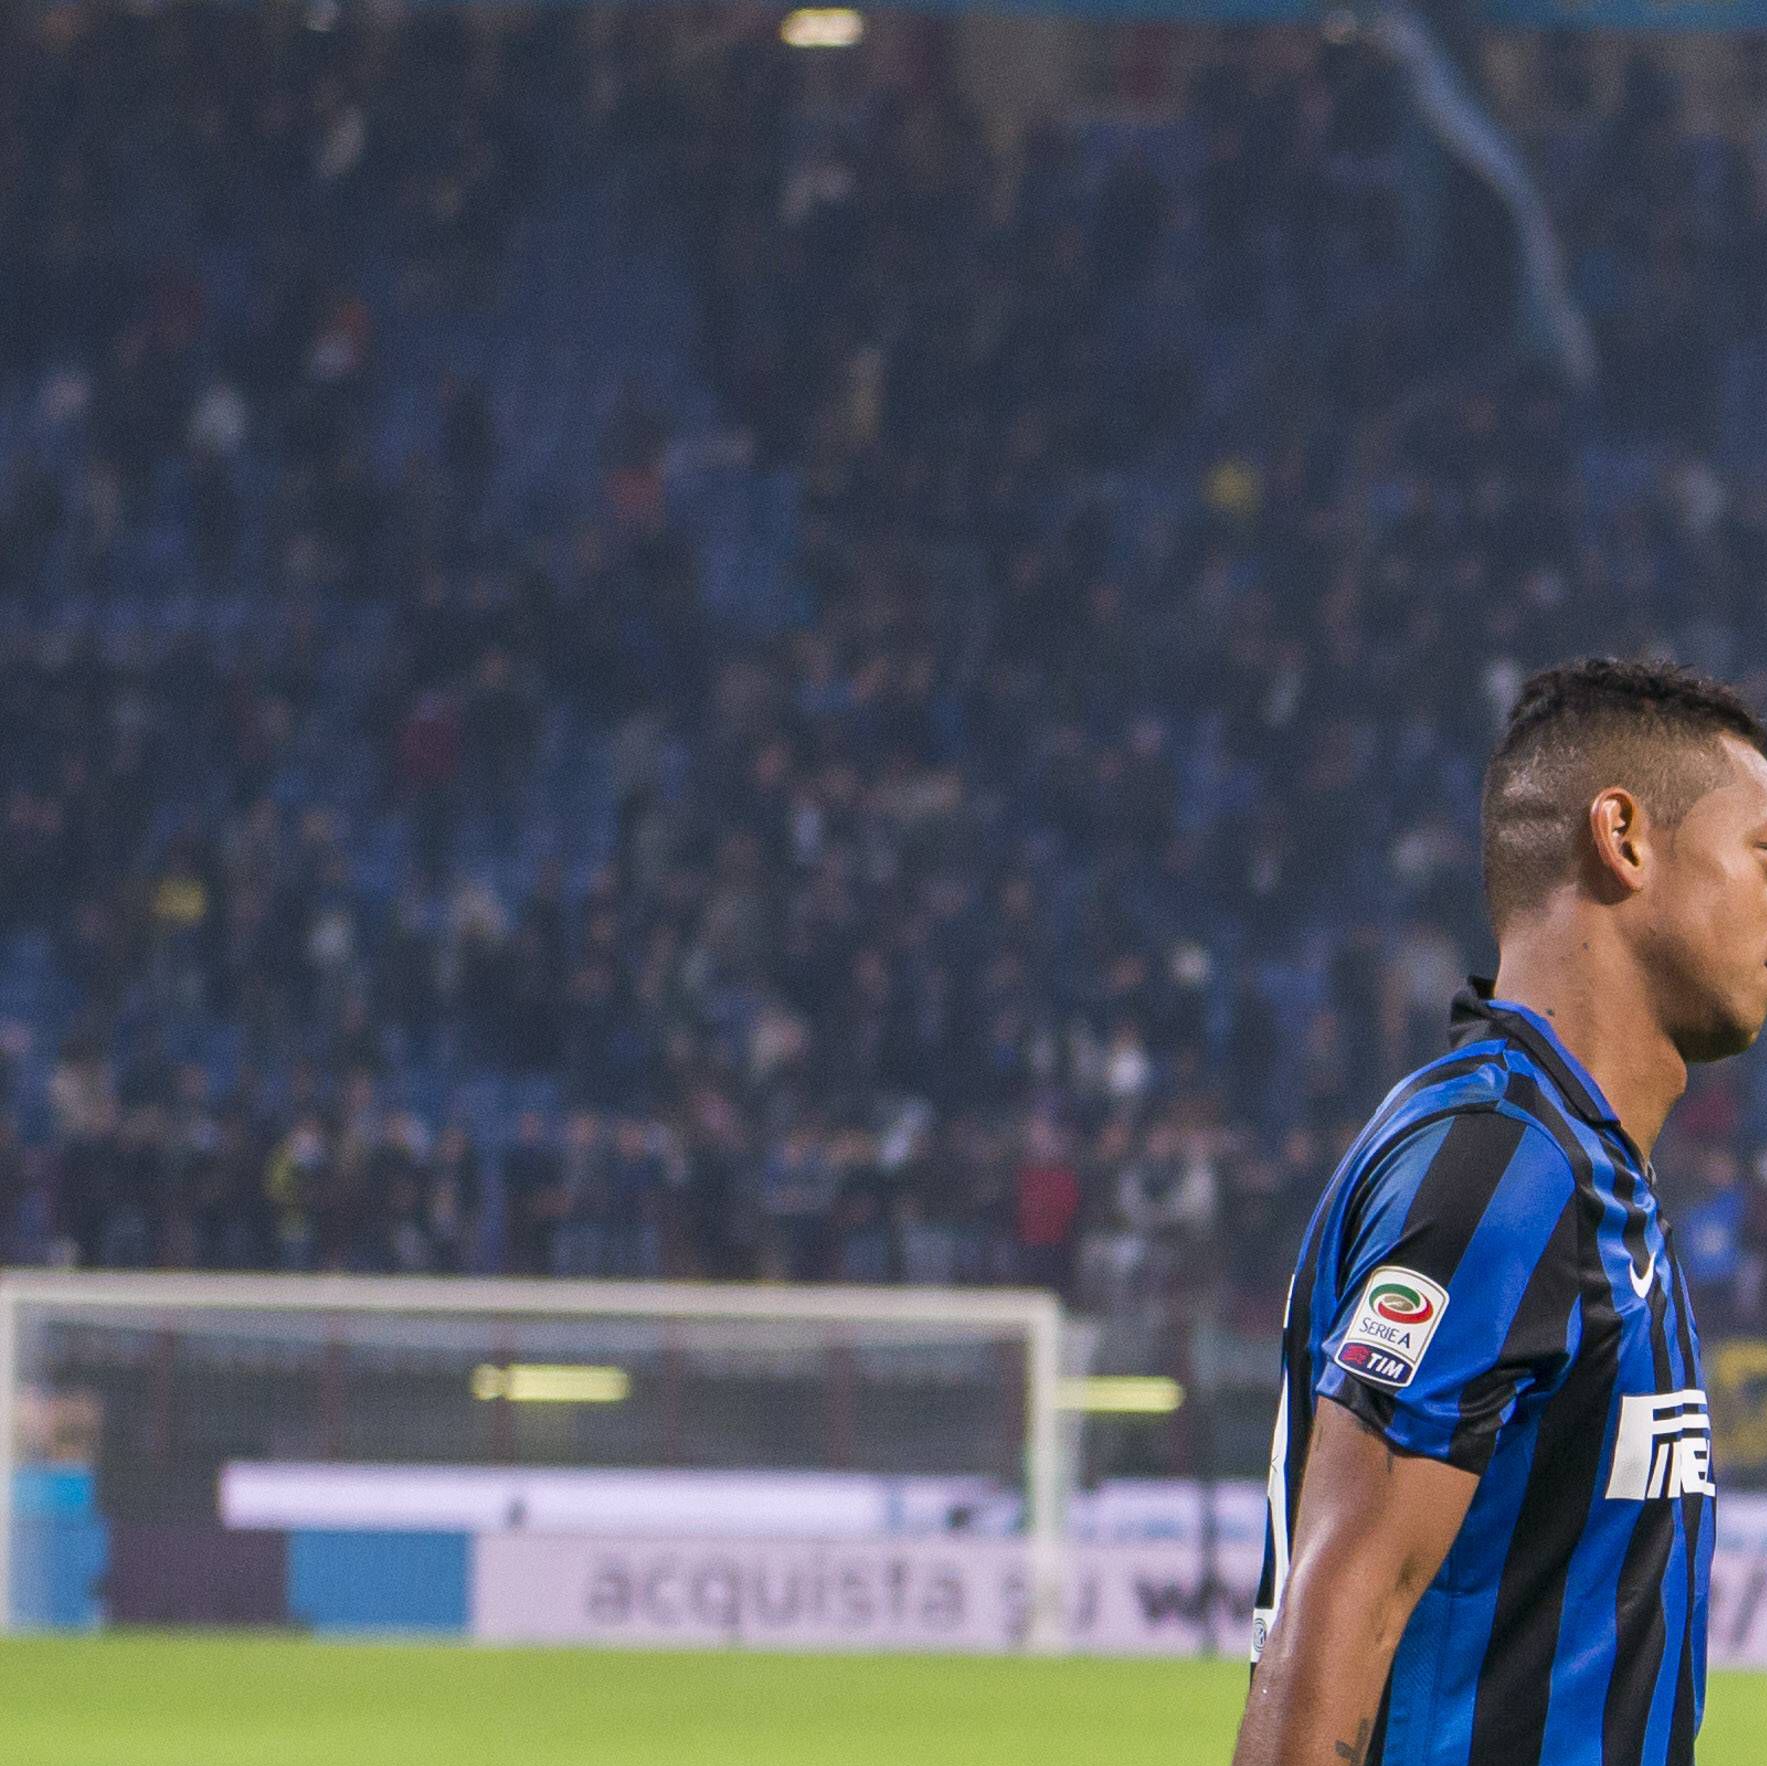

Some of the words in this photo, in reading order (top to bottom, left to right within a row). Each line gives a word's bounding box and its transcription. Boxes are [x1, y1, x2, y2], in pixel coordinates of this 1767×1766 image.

[1360, 1316, 1400, 1343] SERIE
[1397, 1331, 1411, 1349] A
[1366, 1352, 1405, 1379] TIM
[584, 1546, 968, 1642] acquista
